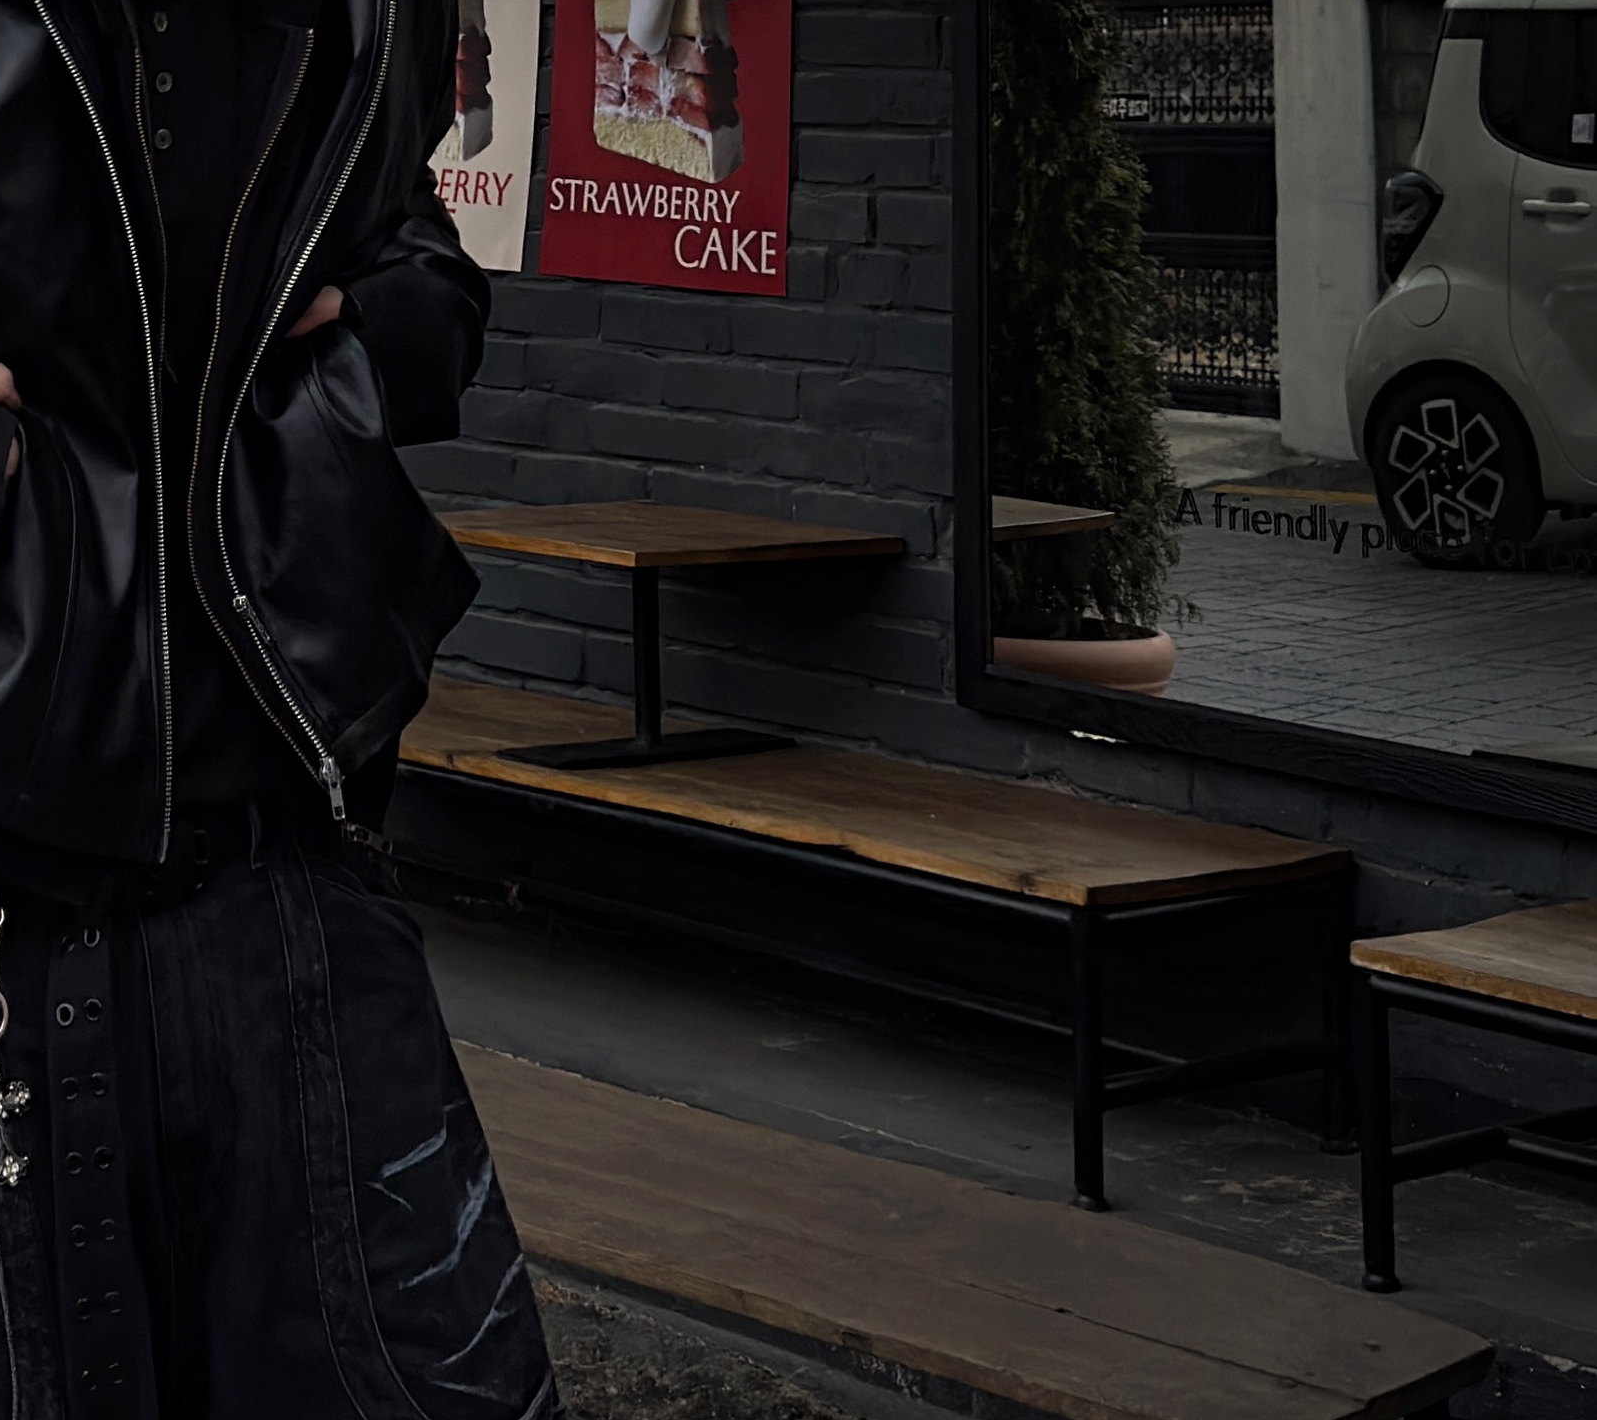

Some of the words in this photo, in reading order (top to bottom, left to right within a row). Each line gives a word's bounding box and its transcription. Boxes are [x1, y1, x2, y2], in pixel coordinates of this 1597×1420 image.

[549, 176, 741, 224] STRAWBERRY
[673, 224, 778, 276] CAKE
[1173, 487, 1202, 525] A
[1212, 492, 1349, 555] friendly
